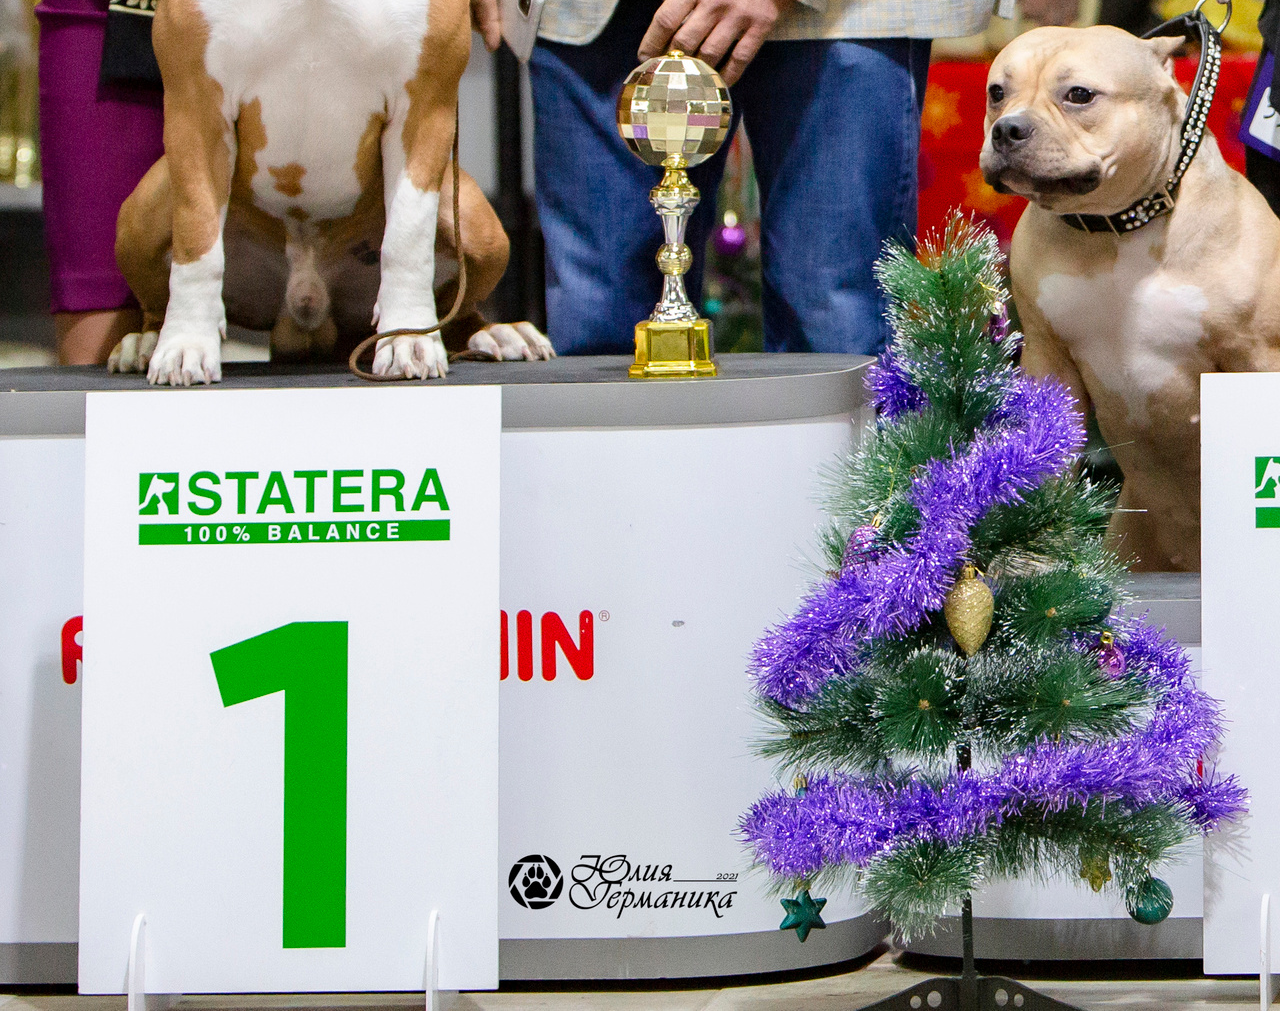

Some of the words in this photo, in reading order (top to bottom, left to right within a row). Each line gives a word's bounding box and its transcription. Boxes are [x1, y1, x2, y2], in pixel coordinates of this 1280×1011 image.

[187, 467, 450, 517] STATERA
[183, 525, 251, 542] 100%
[267, 522, 400, 541] BALANCE
[209, 620, 349, 950] 1
